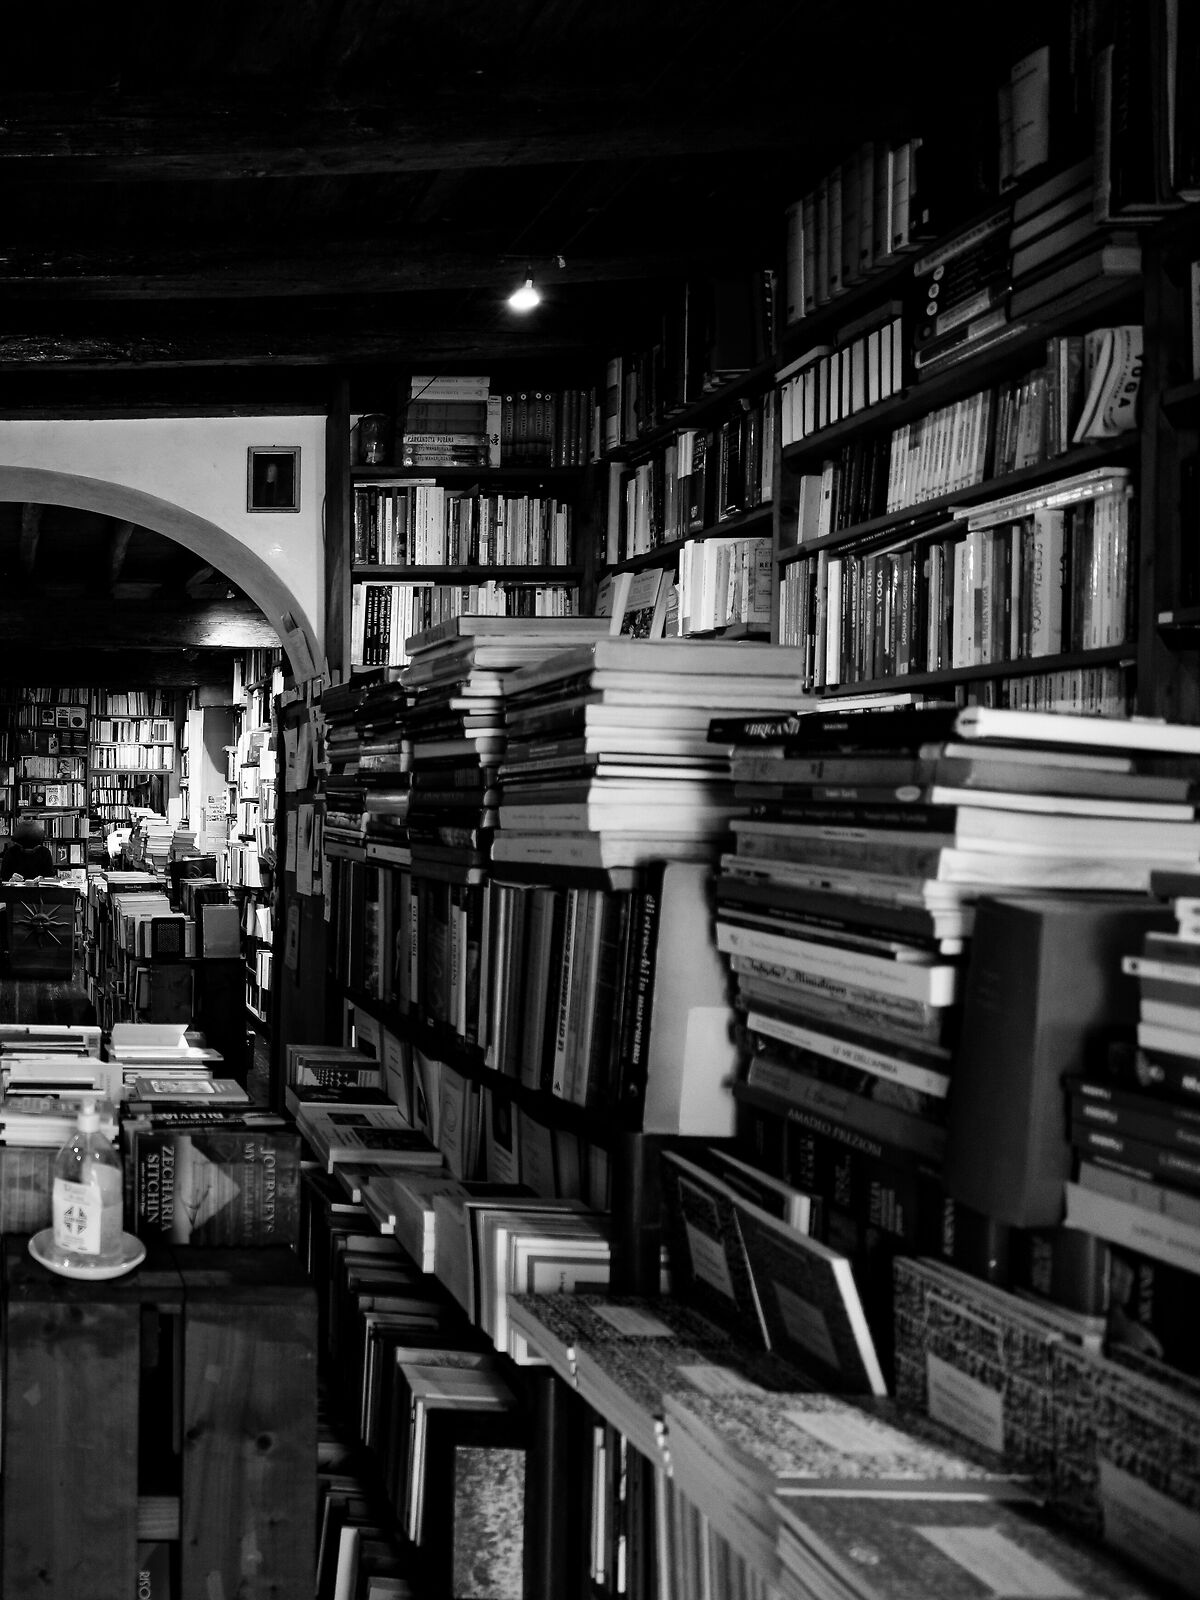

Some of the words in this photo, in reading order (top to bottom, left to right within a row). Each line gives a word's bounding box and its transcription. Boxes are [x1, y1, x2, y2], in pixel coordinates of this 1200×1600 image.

[876, 569, 884, 605] YOGA
[146, 1152, 160, 1224] SITCHIN
[161, 1145, 174, 1233] ZECHARIA
[260, 1146, 276, 1233] JOURNEYS
